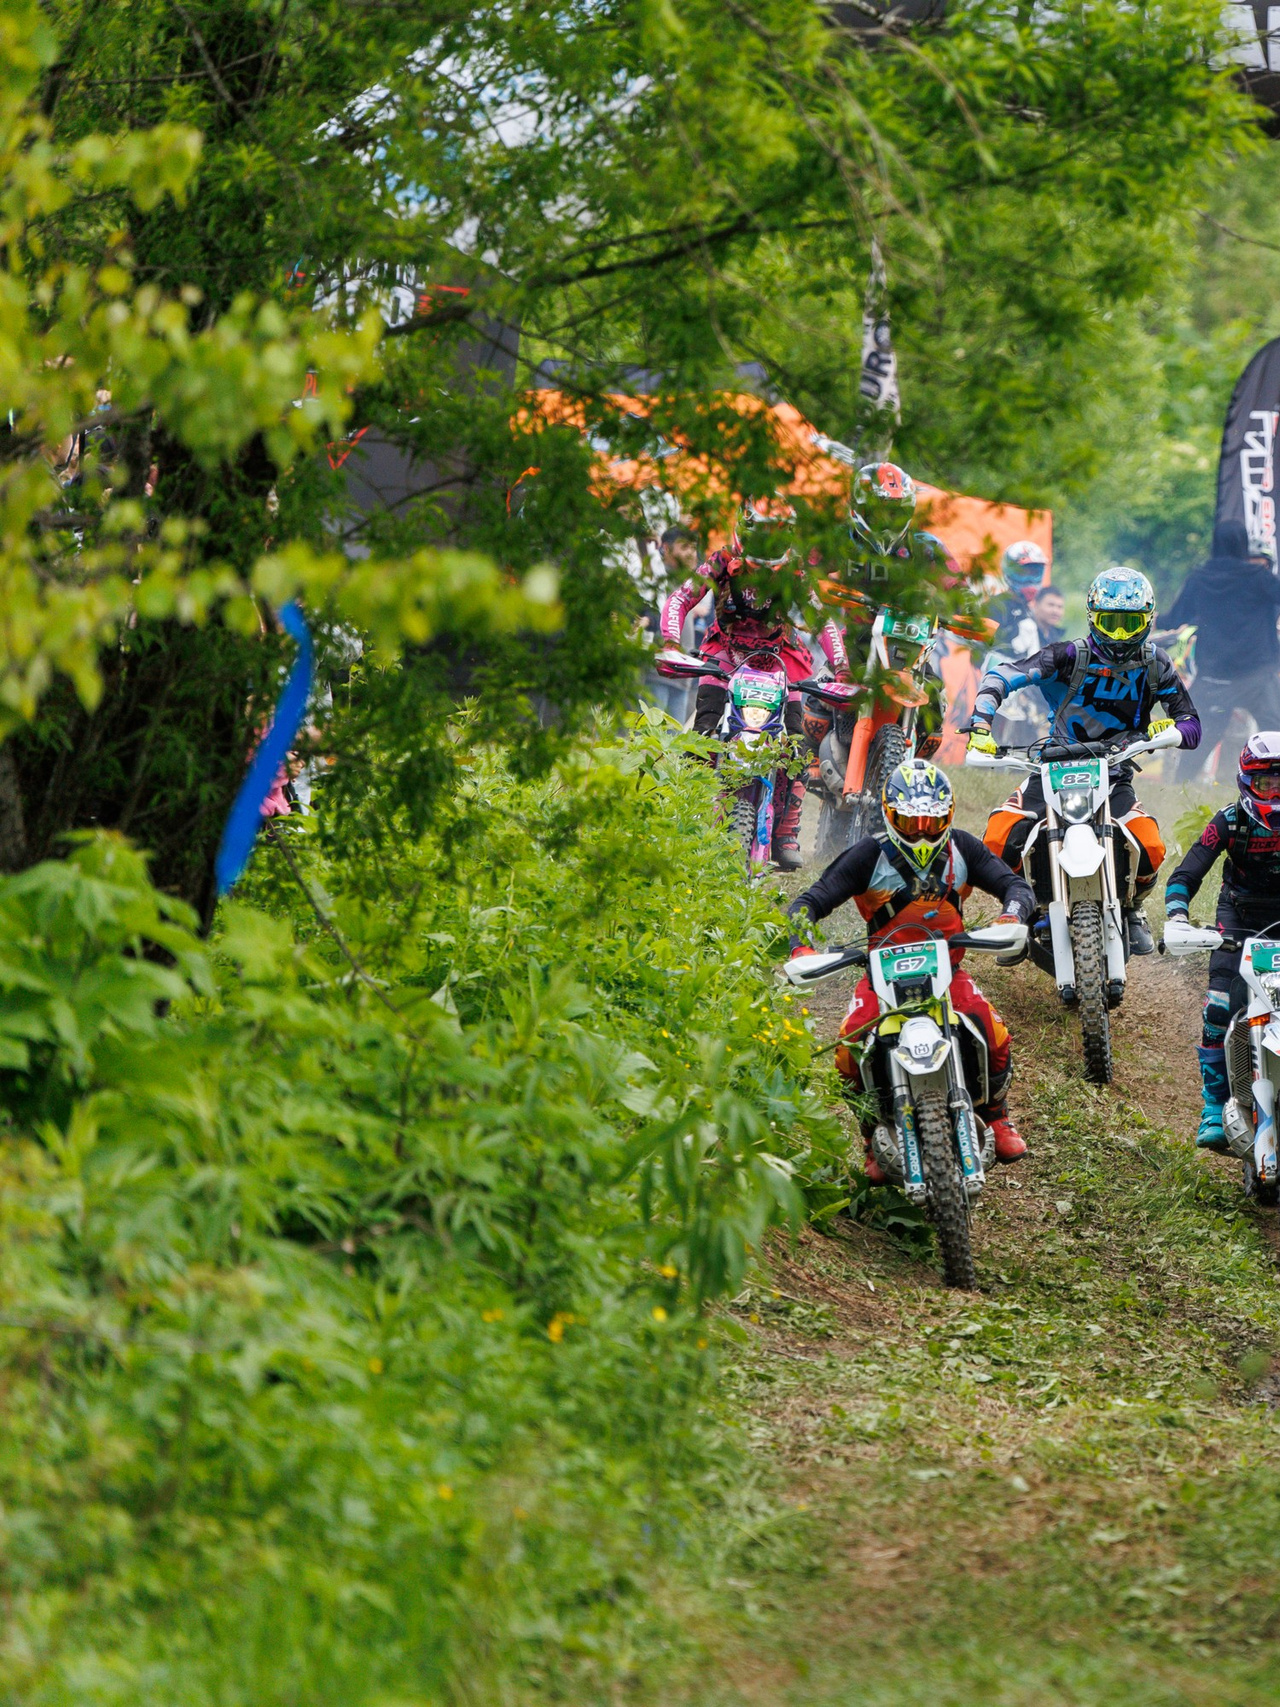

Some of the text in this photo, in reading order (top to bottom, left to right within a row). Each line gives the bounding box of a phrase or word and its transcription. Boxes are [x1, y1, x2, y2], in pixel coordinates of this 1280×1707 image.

[740, 687, 776, 703] 125
[1062, 773, 1091, 785] 82
[894, 956, 926, 973] 67
[906, 1130, 922, 1177] MOTOREX
